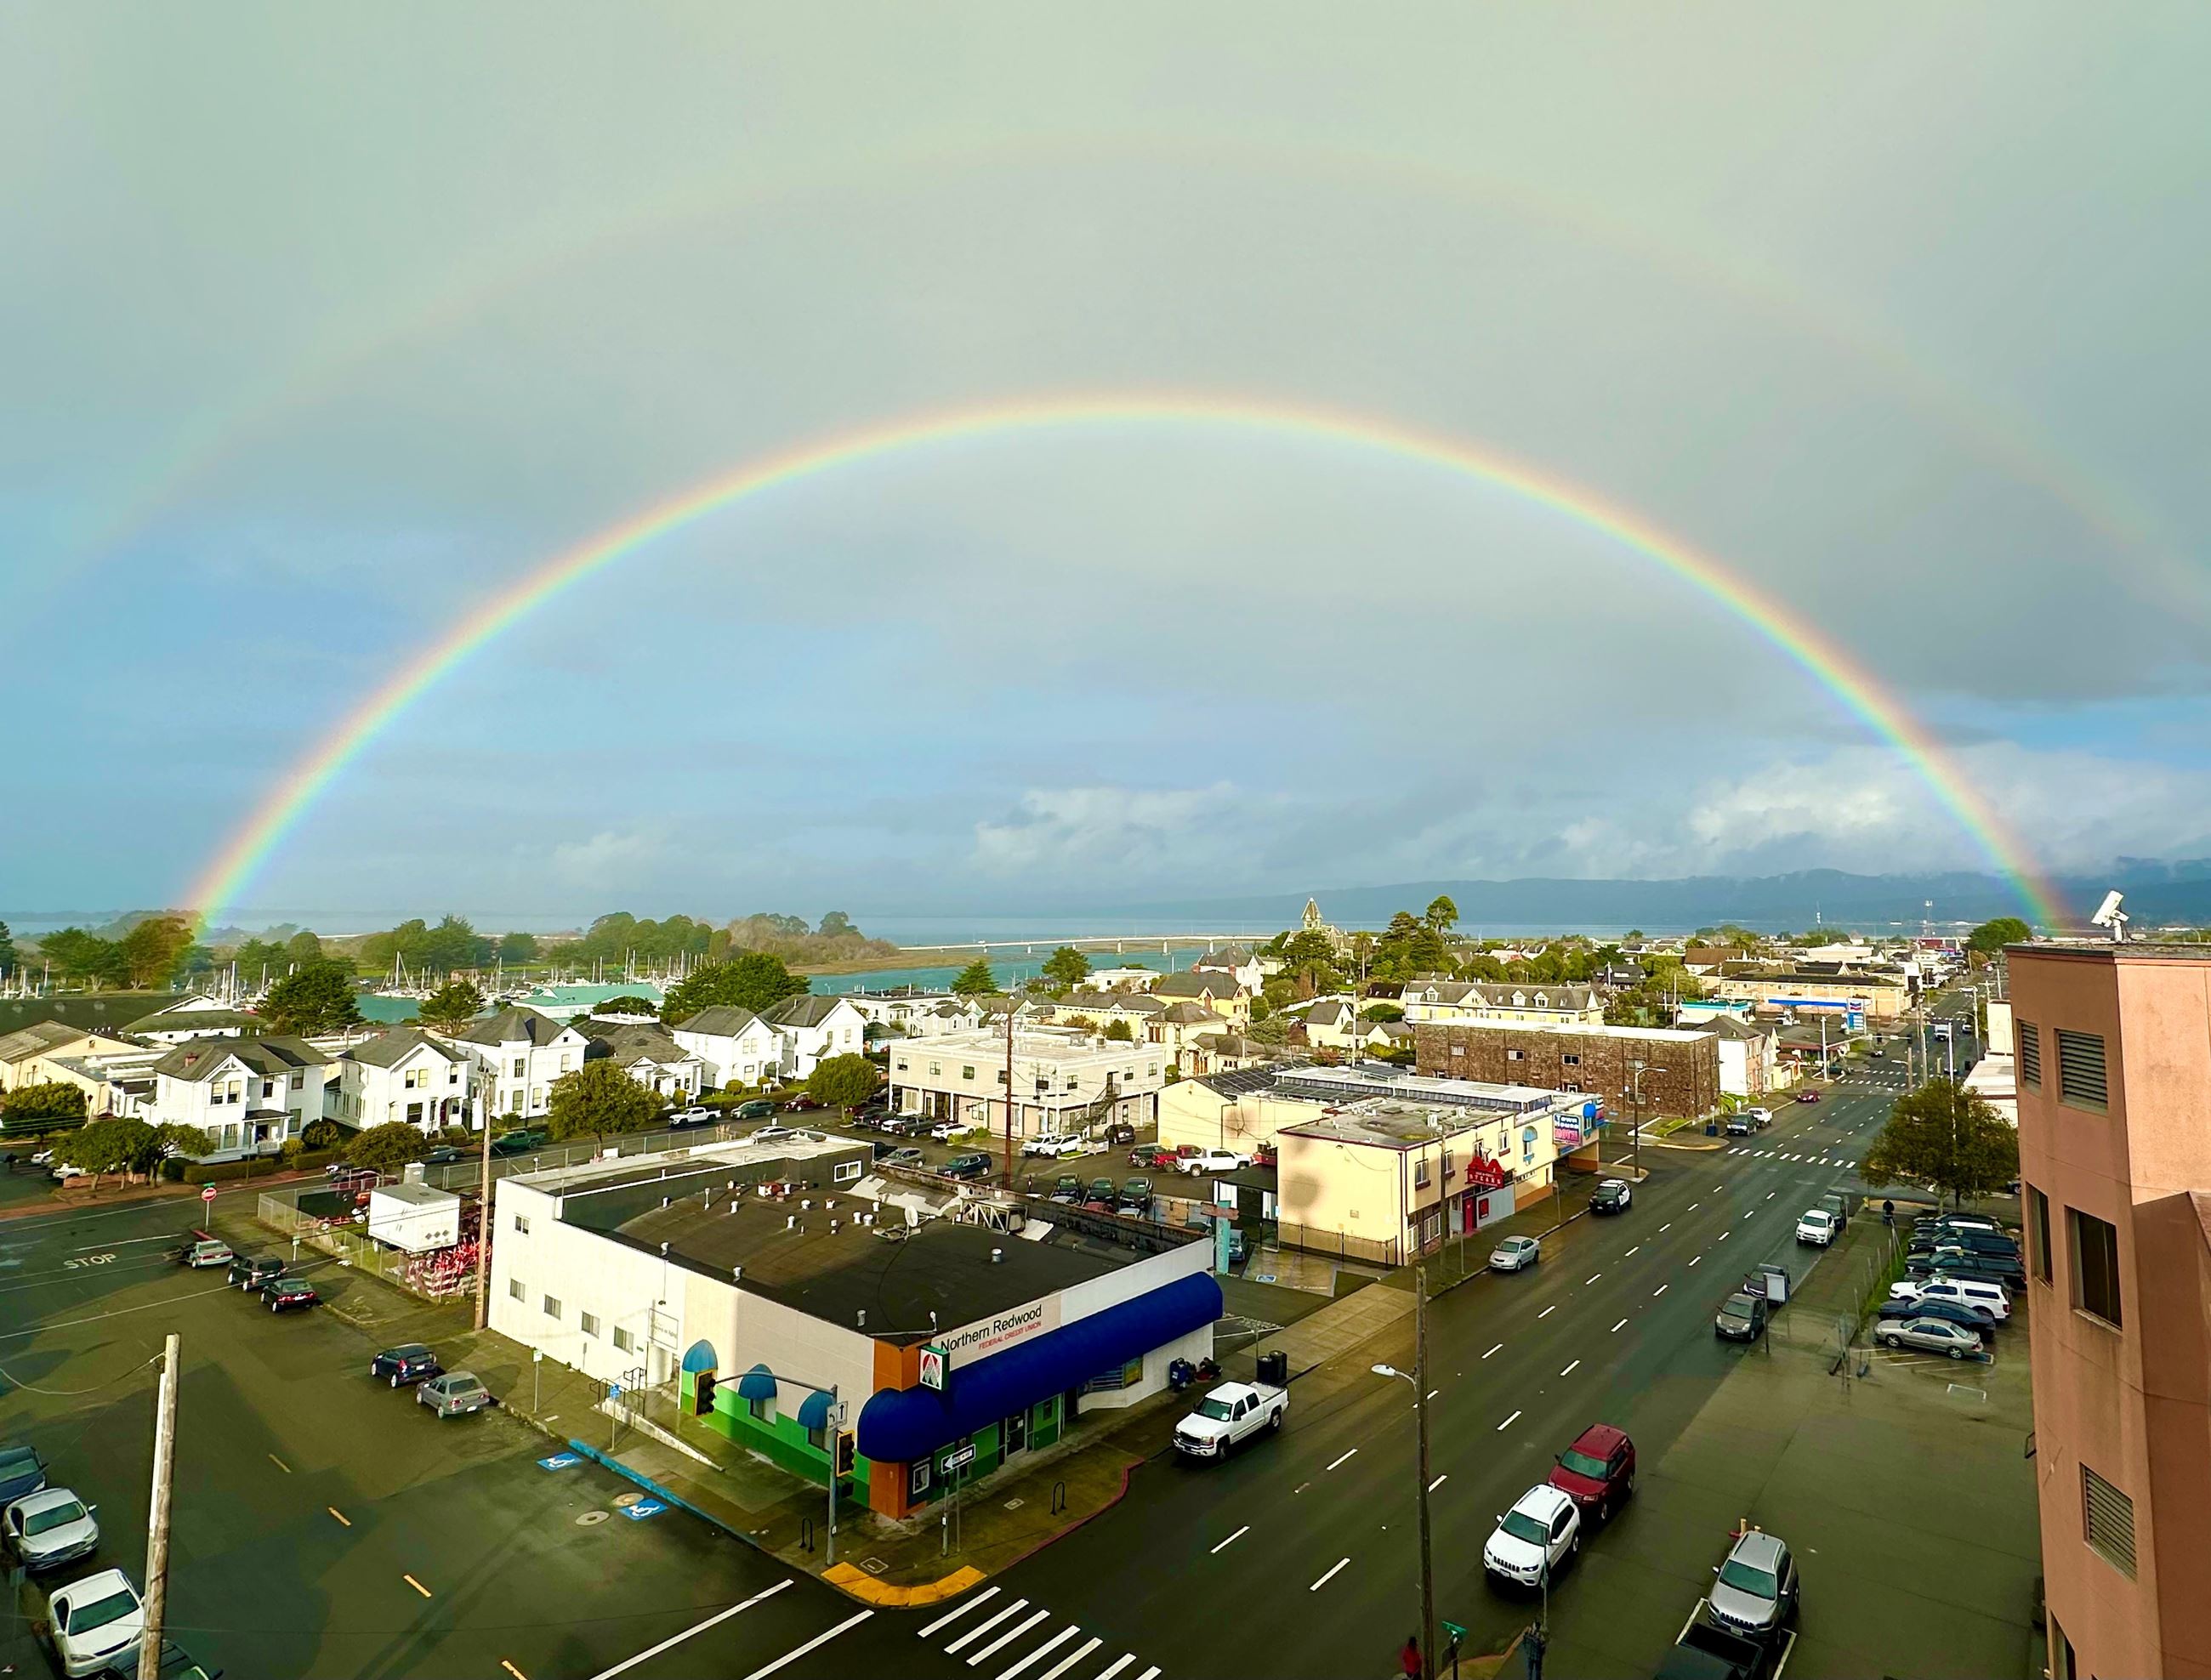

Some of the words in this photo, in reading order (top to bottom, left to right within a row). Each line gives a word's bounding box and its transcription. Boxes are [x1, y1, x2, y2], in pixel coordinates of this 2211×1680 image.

[64, 1253, 117, 1269] STOP
[941, 1327, 990, 1352] Northern
[993, 1304, 1042, 1335] Redwood
[979, 1336, 1003, 1350] FEDERAL
[1004, 1327, 1025, 1341] CREDIT
[1025, 1321, 1042, 1333] UNION
